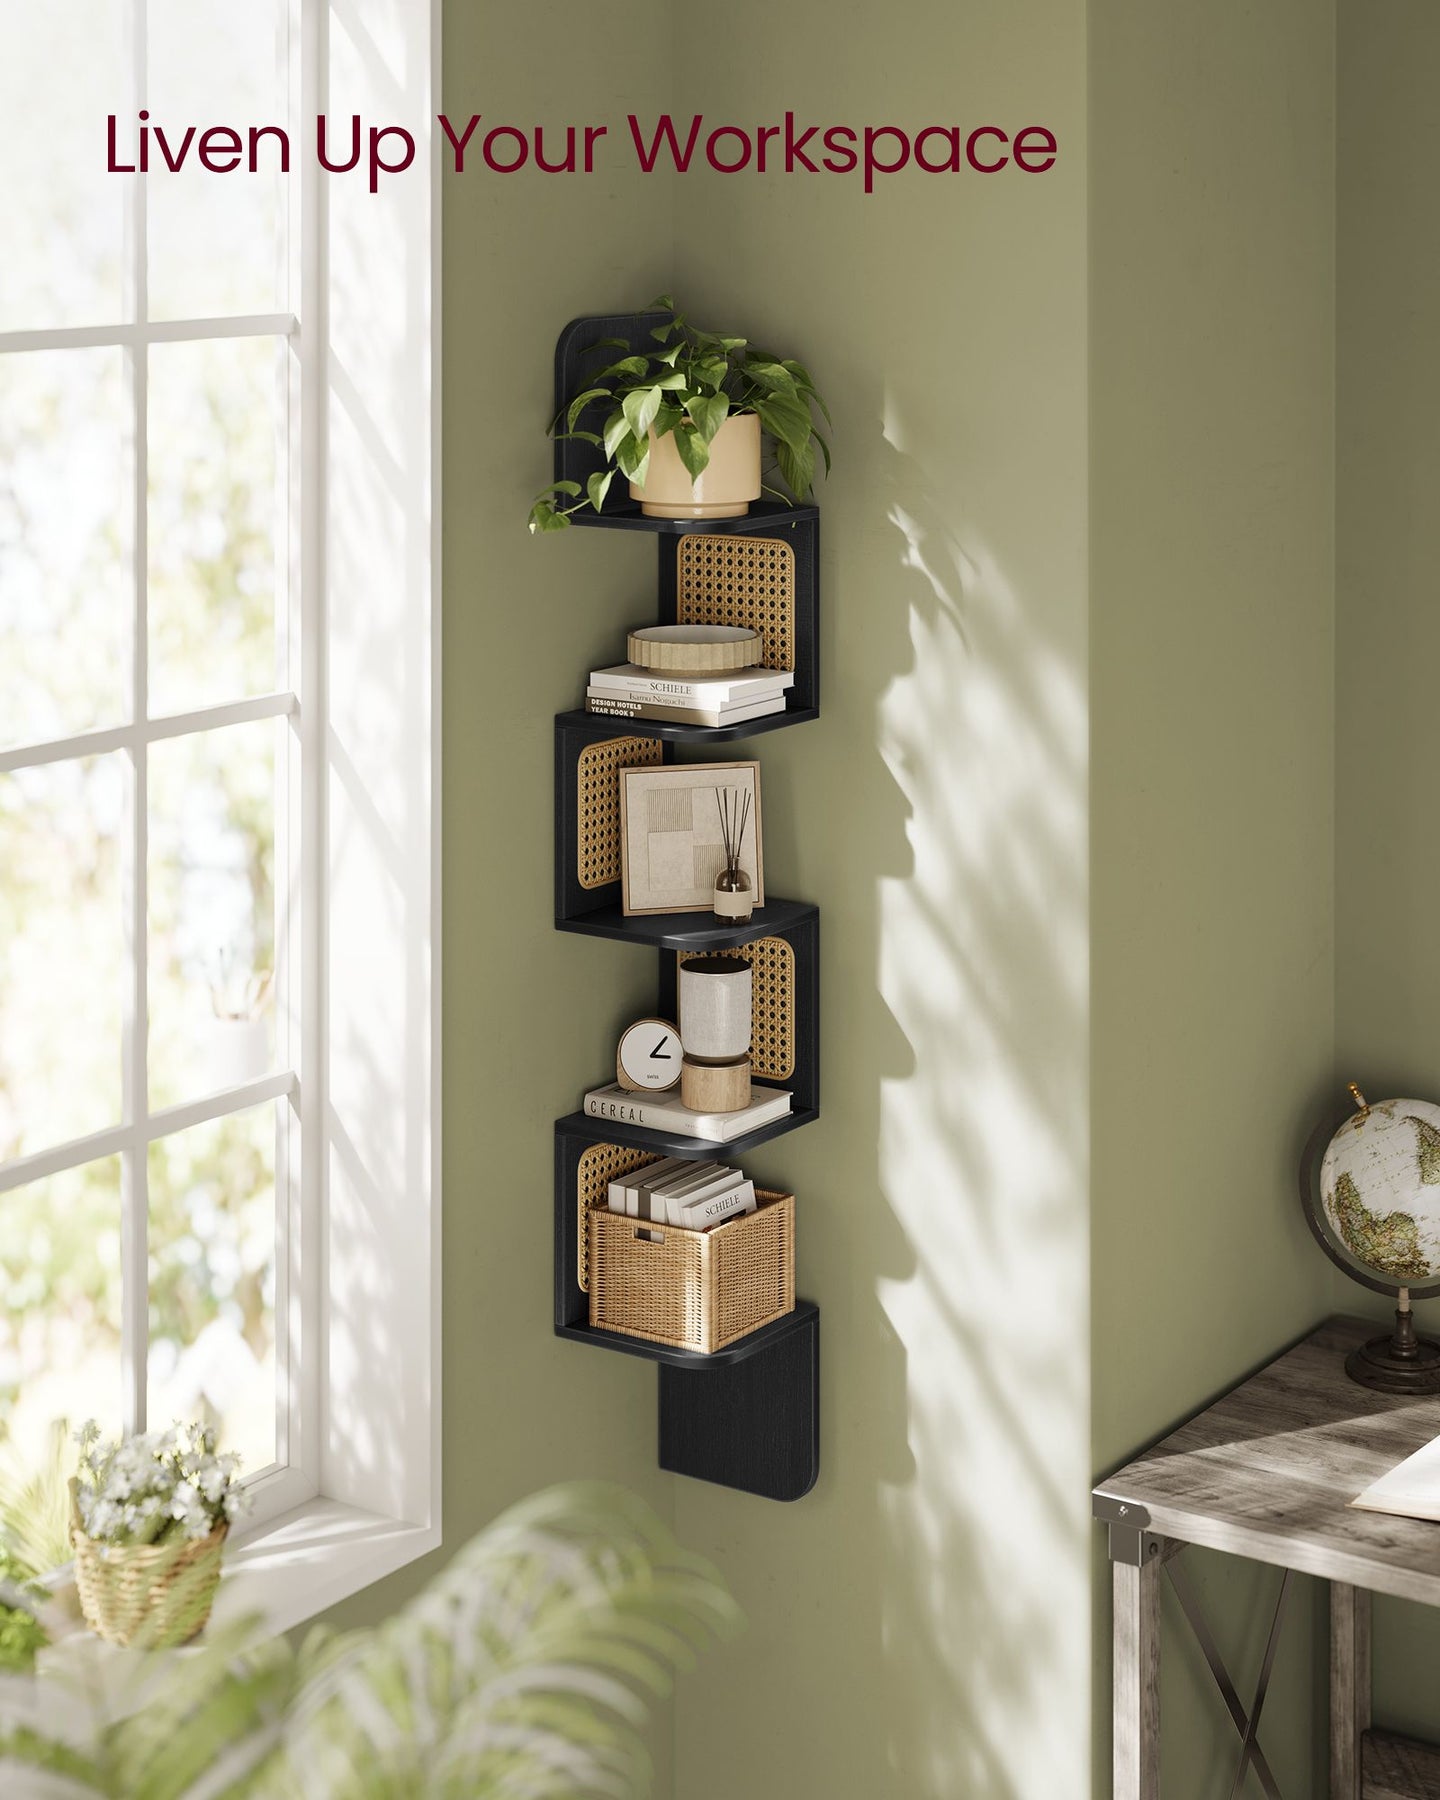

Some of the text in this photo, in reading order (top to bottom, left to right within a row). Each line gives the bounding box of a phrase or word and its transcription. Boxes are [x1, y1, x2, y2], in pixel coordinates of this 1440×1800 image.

[650, 682, 692, 695] SCHIELE
[591, 698, 642, 710] DESIGN HOTELS
[629, 692, 686, 706] Isamu Noguchi
[591, 706, 608, 714] YEAR
[590, 1100, 644, 1123] CEREAL
[705, 1194, 741, 1218] SCHIELE
